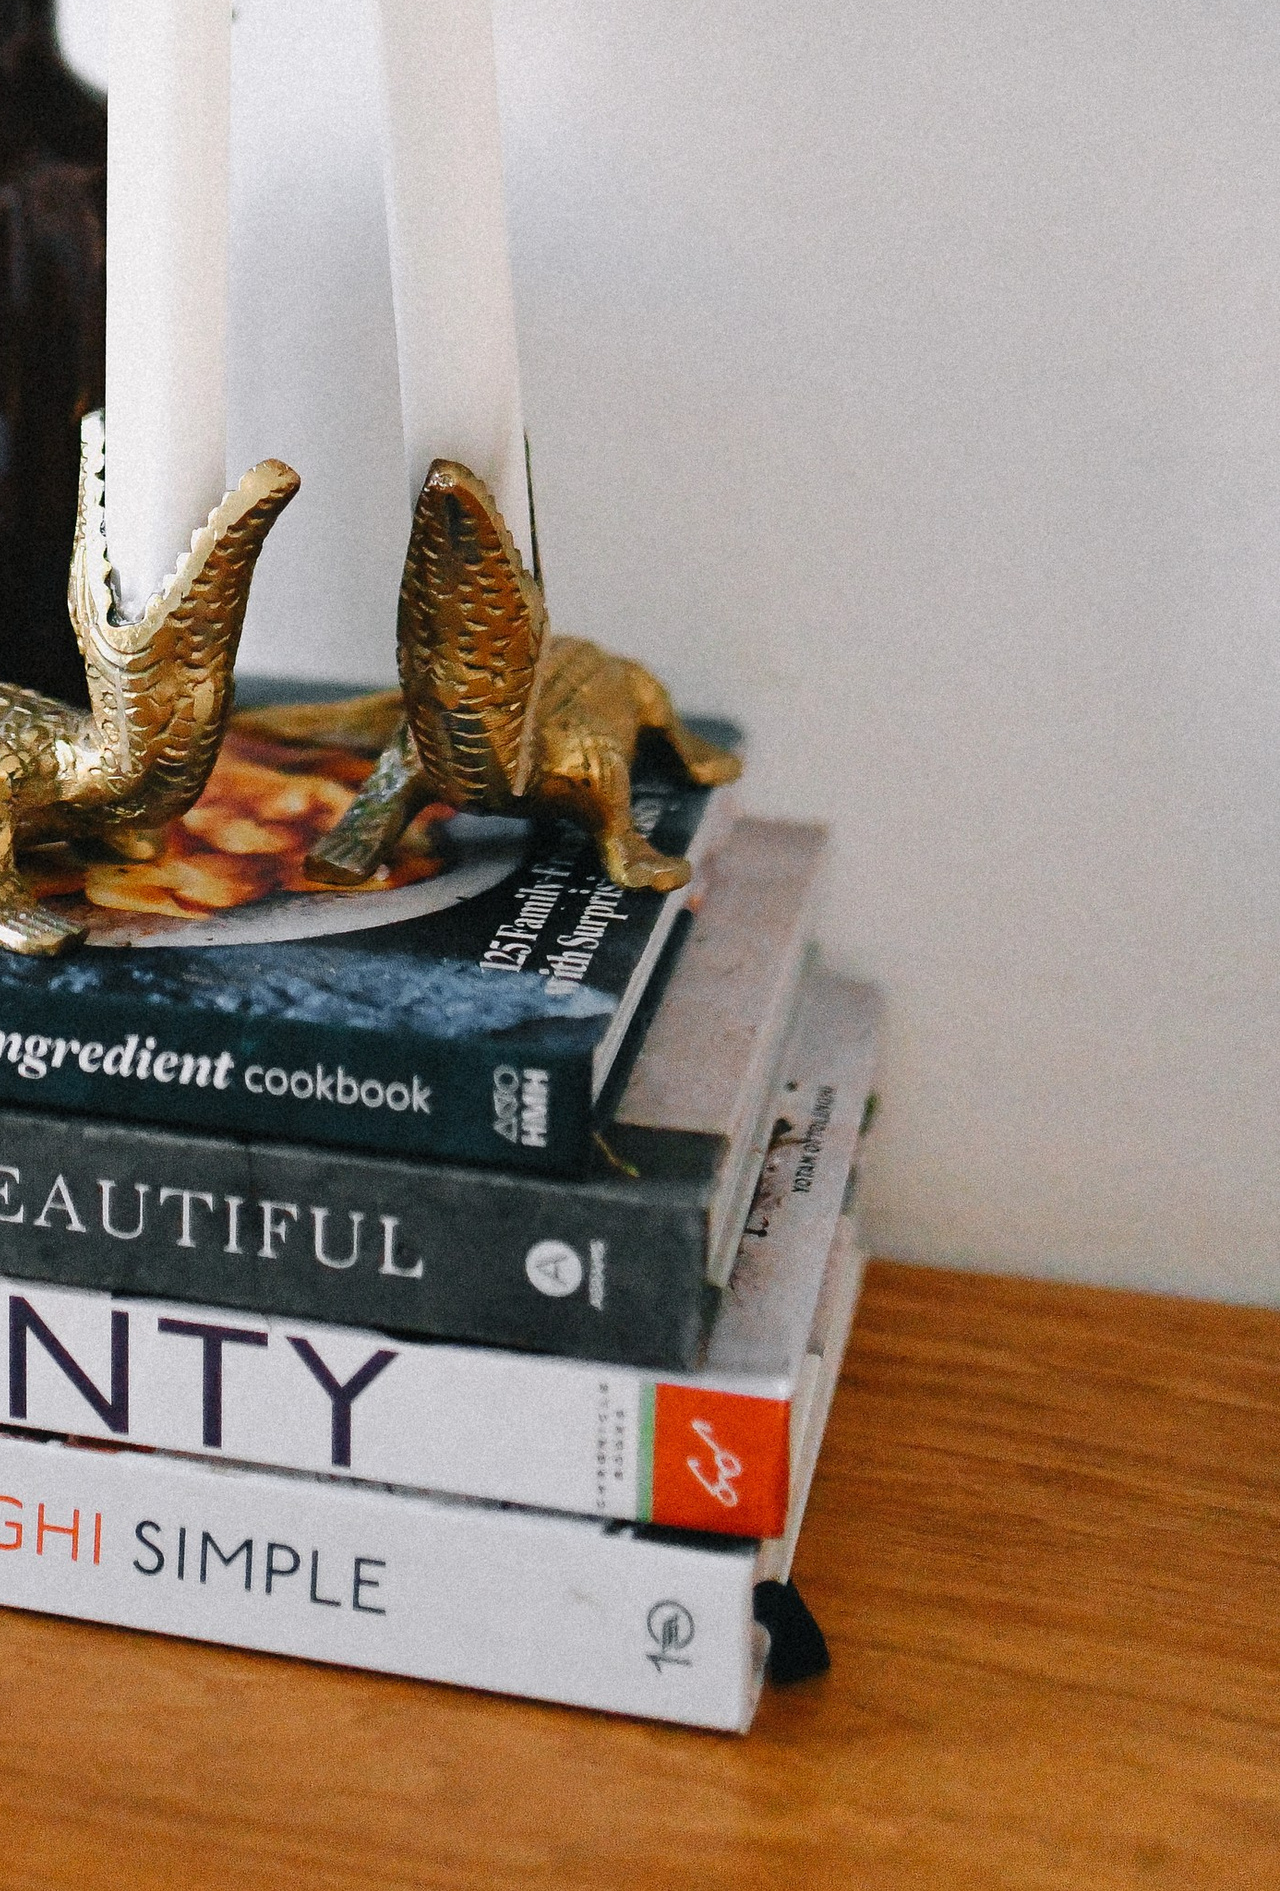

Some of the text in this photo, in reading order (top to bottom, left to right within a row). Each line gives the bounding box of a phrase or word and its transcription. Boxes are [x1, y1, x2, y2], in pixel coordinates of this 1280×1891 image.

[479, 940, 532, 972] 125
[539, 875, 628, 995] with Surpris
[244, 1063, 433, 1115] cookbook
[134, 1521, 388, 1615] SIMPLE
